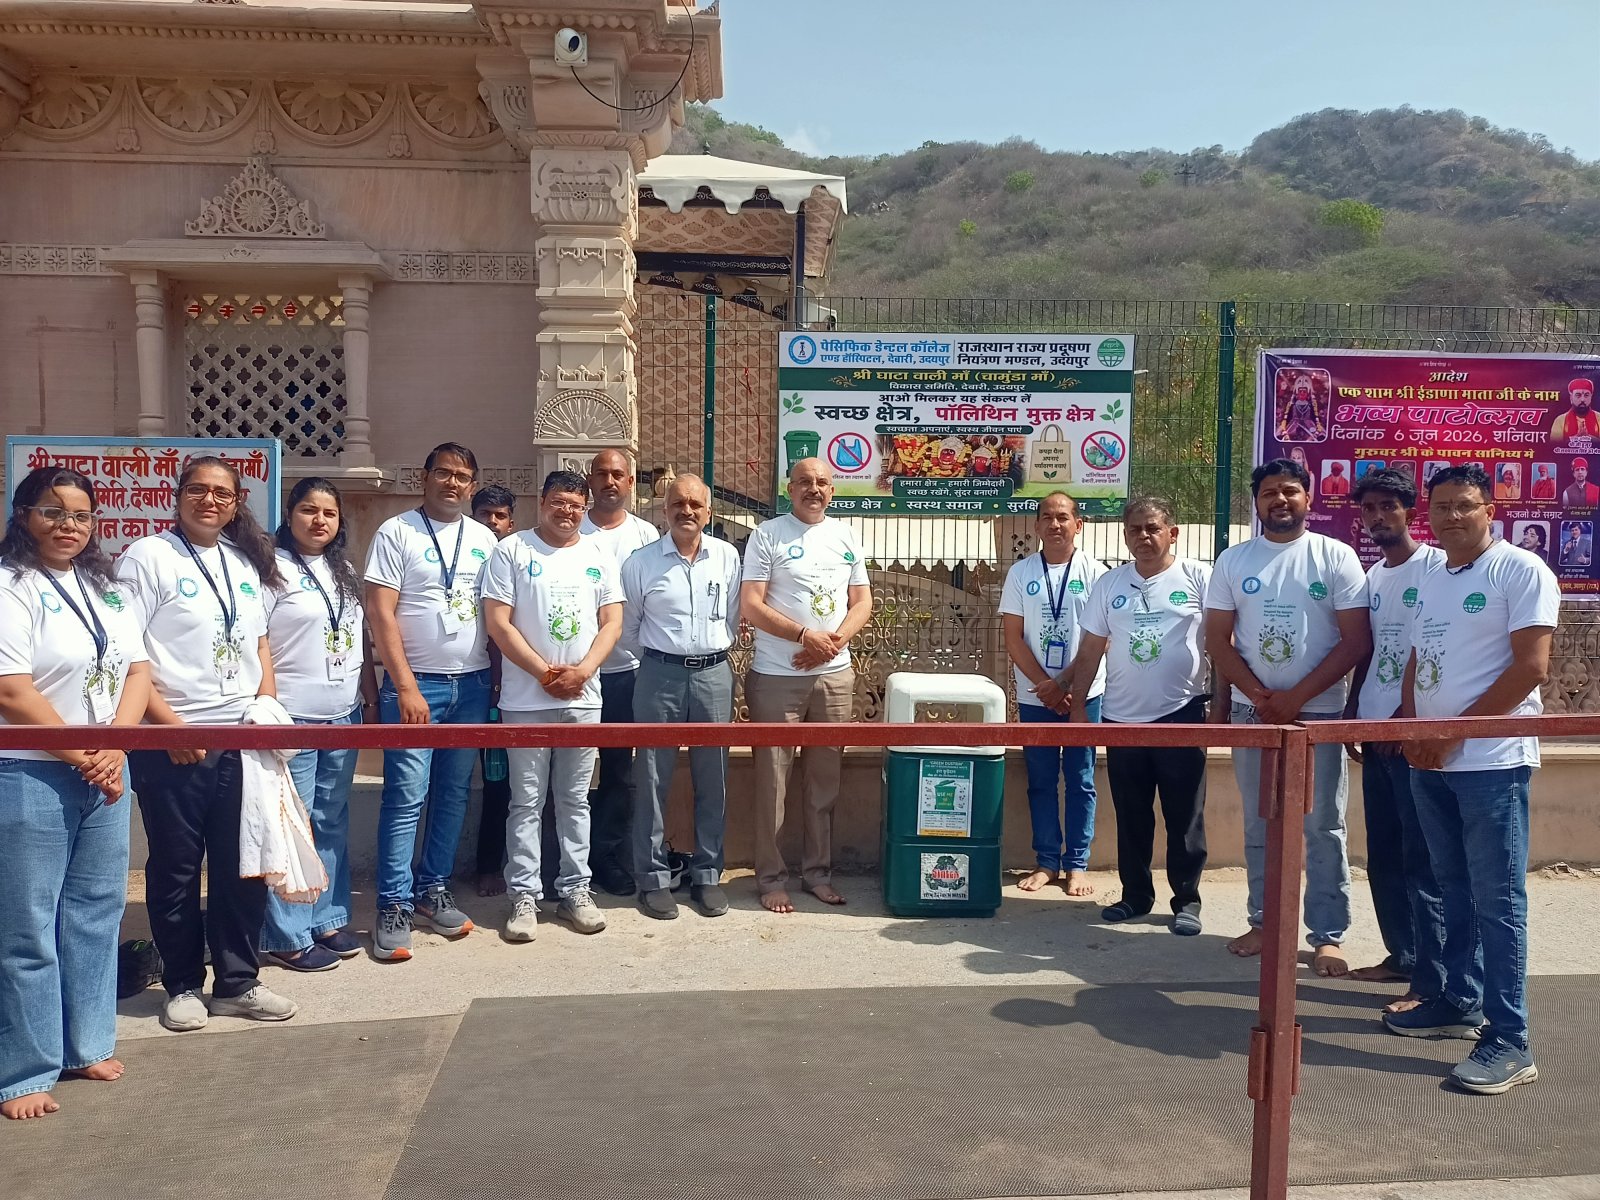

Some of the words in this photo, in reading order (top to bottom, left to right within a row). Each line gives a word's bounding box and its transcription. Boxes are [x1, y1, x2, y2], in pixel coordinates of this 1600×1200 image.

[874, 340, 908, 353] डेन्टल
[910, 340, 951, 353] कॉलेज
[957, 342, 1012, 353] राजस्थान
[1016, 342, 1046, 353] राज्य
[1049, 343, 1091, 357] प्रदूषण
[820, 354, 840, 363] एण्ड
[888, 353, 916, 365] देबारी,
[919, 355, 951, 366] उदयपुर
[957, 353, 1000, 365] नियंत्रण
[1005, 356, 1045, 367] मण्डल,
[1050, 356, 1090, 369] उदयपुर
[853, 369, 872, 380] श्री
[876, 371, 908, 381] घाटा
[913, 370, 948, 381] वाली
[952, 369, 970, 381] माँ
[975, 371, 1027, 384] (चामुंडा
[1429, 370, 1468, 382] आदेश
[889, 382, 921, 390] विकास
[993, 384, 1026, 392] उदयपुर
[1338, 387, 1362, 399] एक
[1365, 388, 1393, 399] शाम
[1396, 385, 1415, 399] श्री
[1417, 385, 1459, 401] ईडाणा
[1461, 389, 1493, 400] माता
[1496, 388, 1514, 401] जी
[1516, 387, 1532, 401] के
[1535, 390, 1561, 401] नाम
[879, 393, 911, 402] आओ
[915, 393, 957, 402] मिलकर
[960, 395, 977, 403] यह
[981, 394, 1016, 402] संकल्प
[1021, 394, 1032, 403] लें
[814, 405, 870, 421] स्वच्छ
[876, 402, 921, 424] क्षेत्र,
[935, 404, 1018, 421] पॉलिथिन
[1026, 408, 1062, 426] मुक्त
[1066, 404, 1096, 421] क्षेत्र
[1335, 404, 1403, 423] भव्य
[1408, 402, 1549, 425] पाटोत्सव
[1331, 425, 1385, 441] दिनांक
[1394, 430, 1404, 441] 6
[1409, 428, 1439, 445] जून
[1443, 430, 1488, 443] 2026,
[1493, 427, 1548, 443] शनिवार
[1400, 447, 1418, 457] श्री
[1420, 446, 1434, 457] के
[1436, 449, 1471, 457] पावन
[1474, 448, 1521, 458] सानिध्य
[101, 447, 152, 480] वाली
[153, 448, 180, 478] माँ
[924, 479, 937, 488] क्षेत्र
[948, 479, 970, 487] हमारी
[972, 479, 1005, 487] जिम्मेदारी
[954, 489, 971, 498] सुंदर
[861, 499, 883, 510] क्षेत्र
[907, 500, 941, 510] स्वस्थ
[945, 500, 983, 510] समाज
[1506, 509, 1529, 519] भजनो
[1531, 509, 1541, 518] के
[1542, 510, 1563, 520] सम्राट
[121, 518, 150, 538] का
